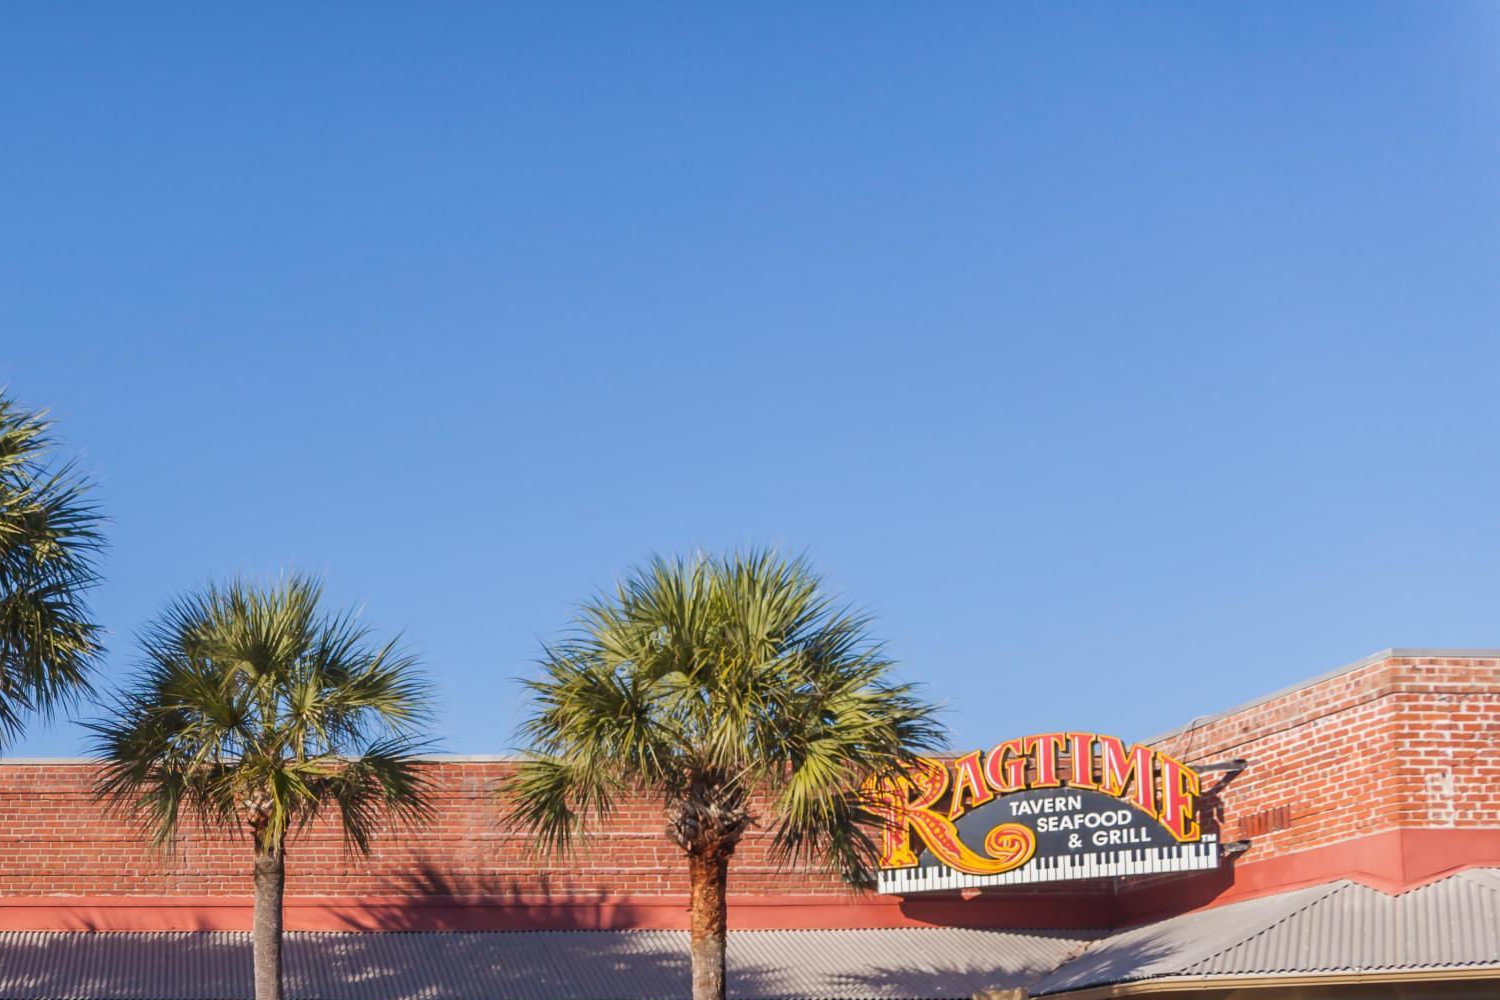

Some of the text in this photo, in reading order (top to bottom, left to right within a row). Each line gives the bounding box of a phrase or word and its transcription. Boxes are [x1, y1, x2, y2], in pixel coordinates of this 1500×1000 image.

[860, 732, 1200, 874] RAGTIME
[1009, 796, 1082, 816] TAVERN
[1036, 810, 1132, 833] SEAFOOD
[1068, 827, 1152, 849] & GRILL
